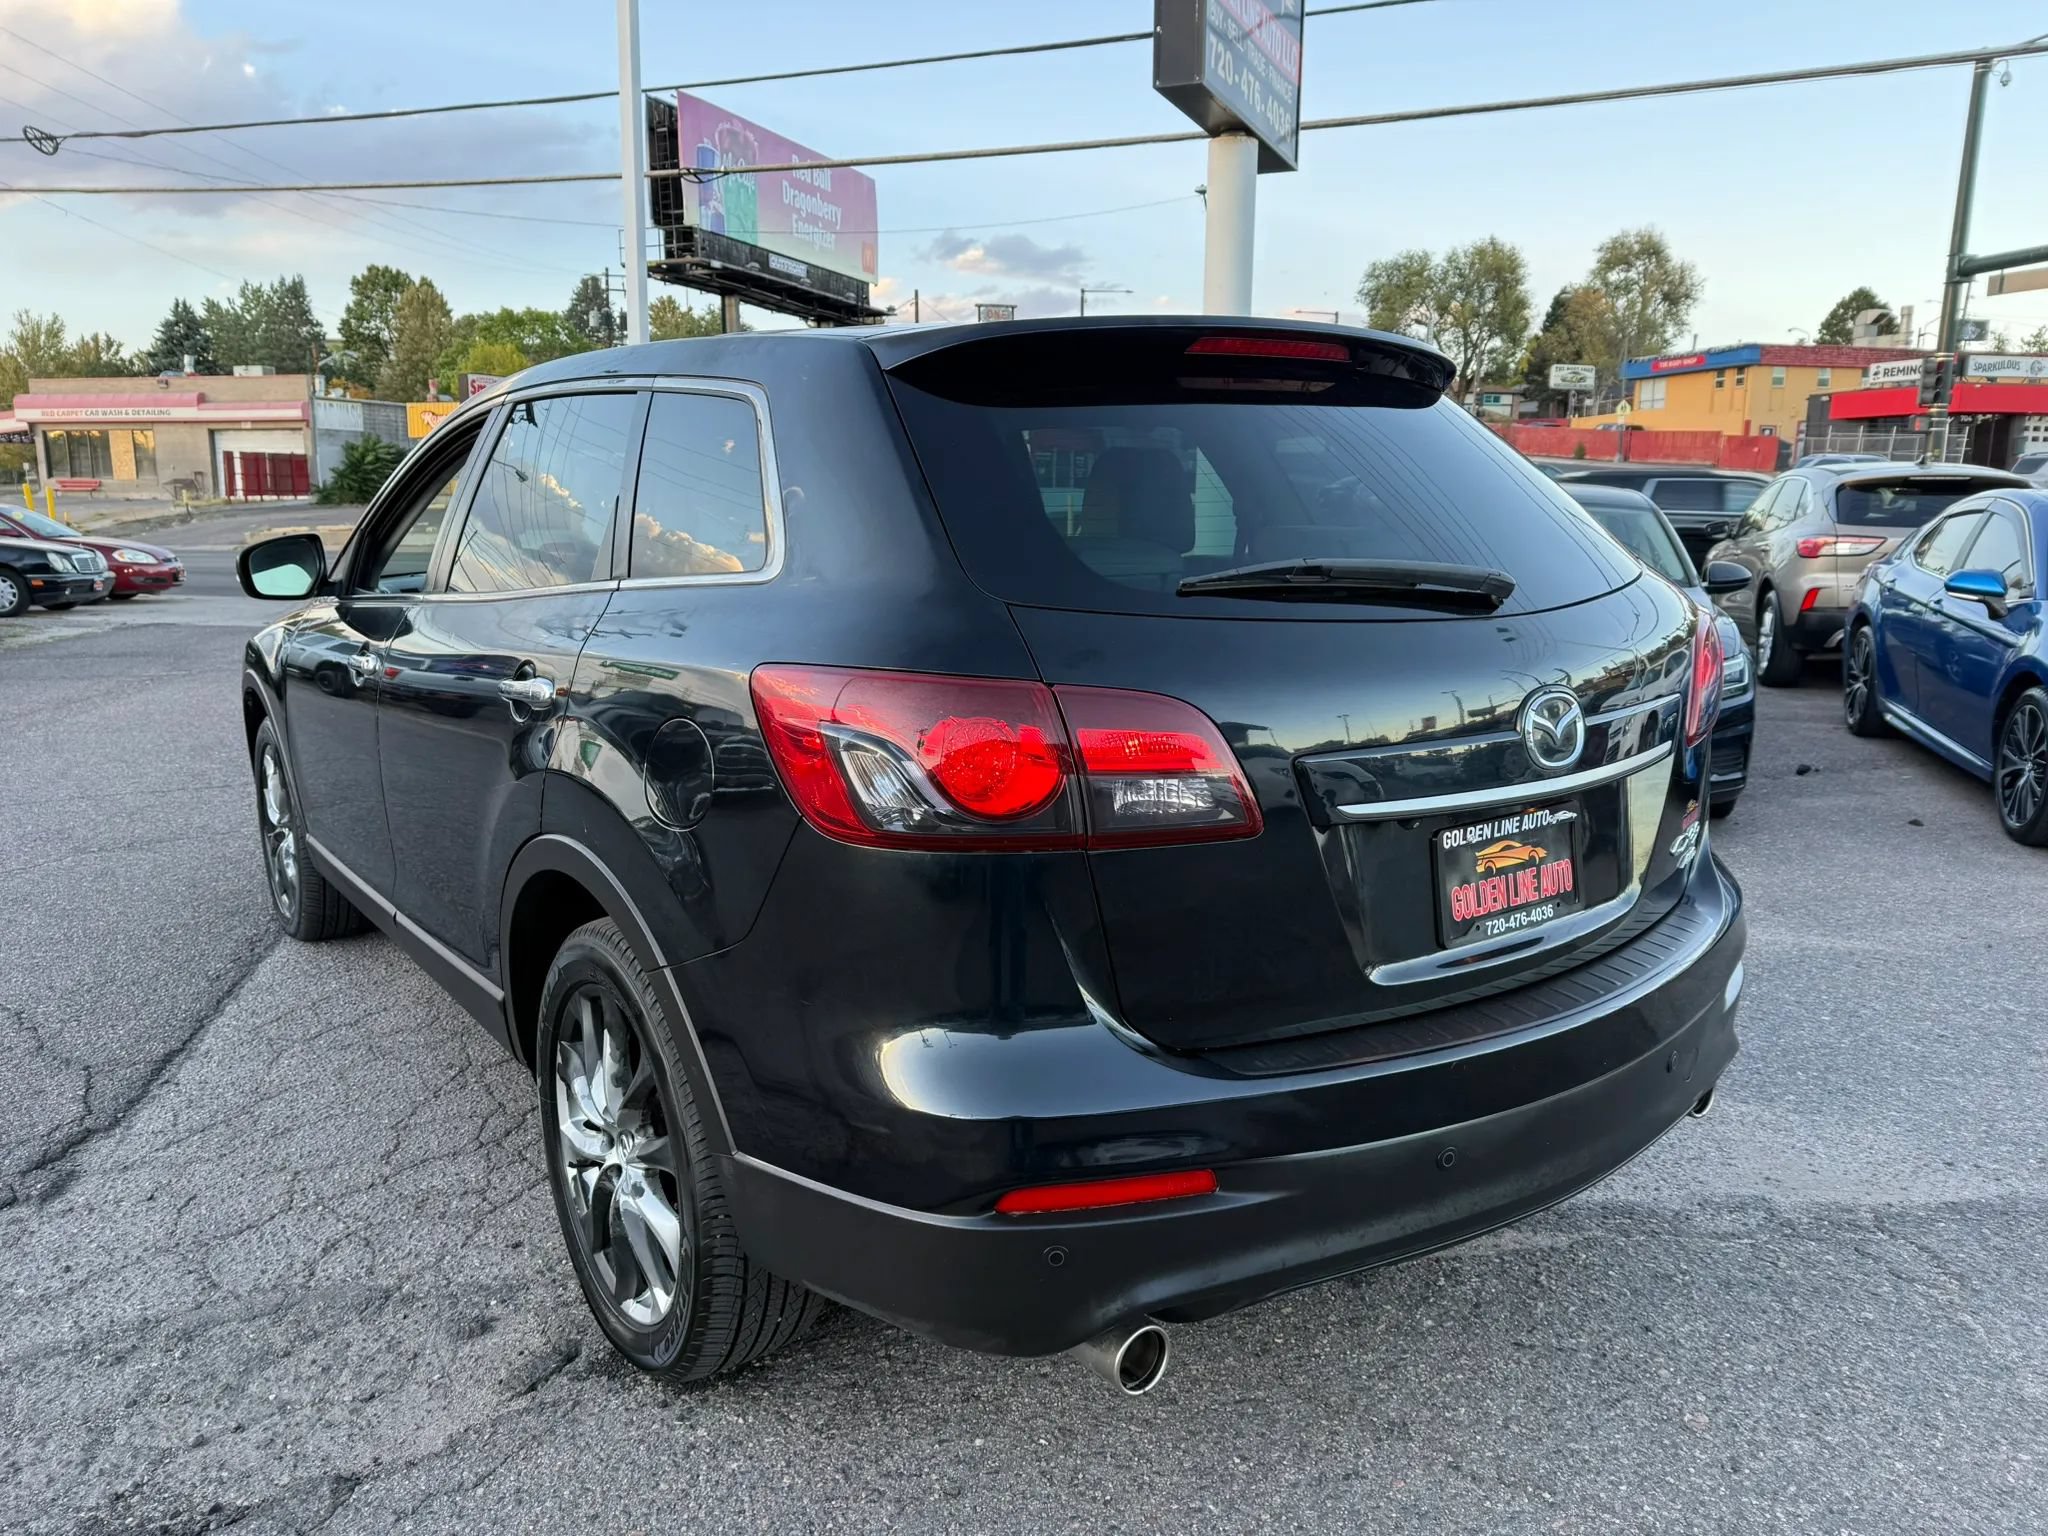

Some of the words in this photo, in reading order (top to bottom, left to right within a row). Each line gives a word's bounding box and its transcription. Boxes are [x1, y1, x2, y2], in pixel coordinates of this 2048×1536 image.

[782, 179, 842, 231] Dragonberry
[792, 214, 836, 250] Energizer
[1973, 360, 2020, 373] SPARKULOUS
[41, 409, 54, 417] RED
[57, 409, 82, 417] CARPET
[1443, 822, 1491, 849] GOLDEN
[1493, 817, 1520, 838] LINE
[1522, 809, 1550, 830] AUTO
[1451, 873, 1508, 922] GOLDEN
[1509, 867, 1538, 907] LINE
[1540, 859, 1573, 899] AUTO
[1486, 904, 1554, 935] 720-476-4036
